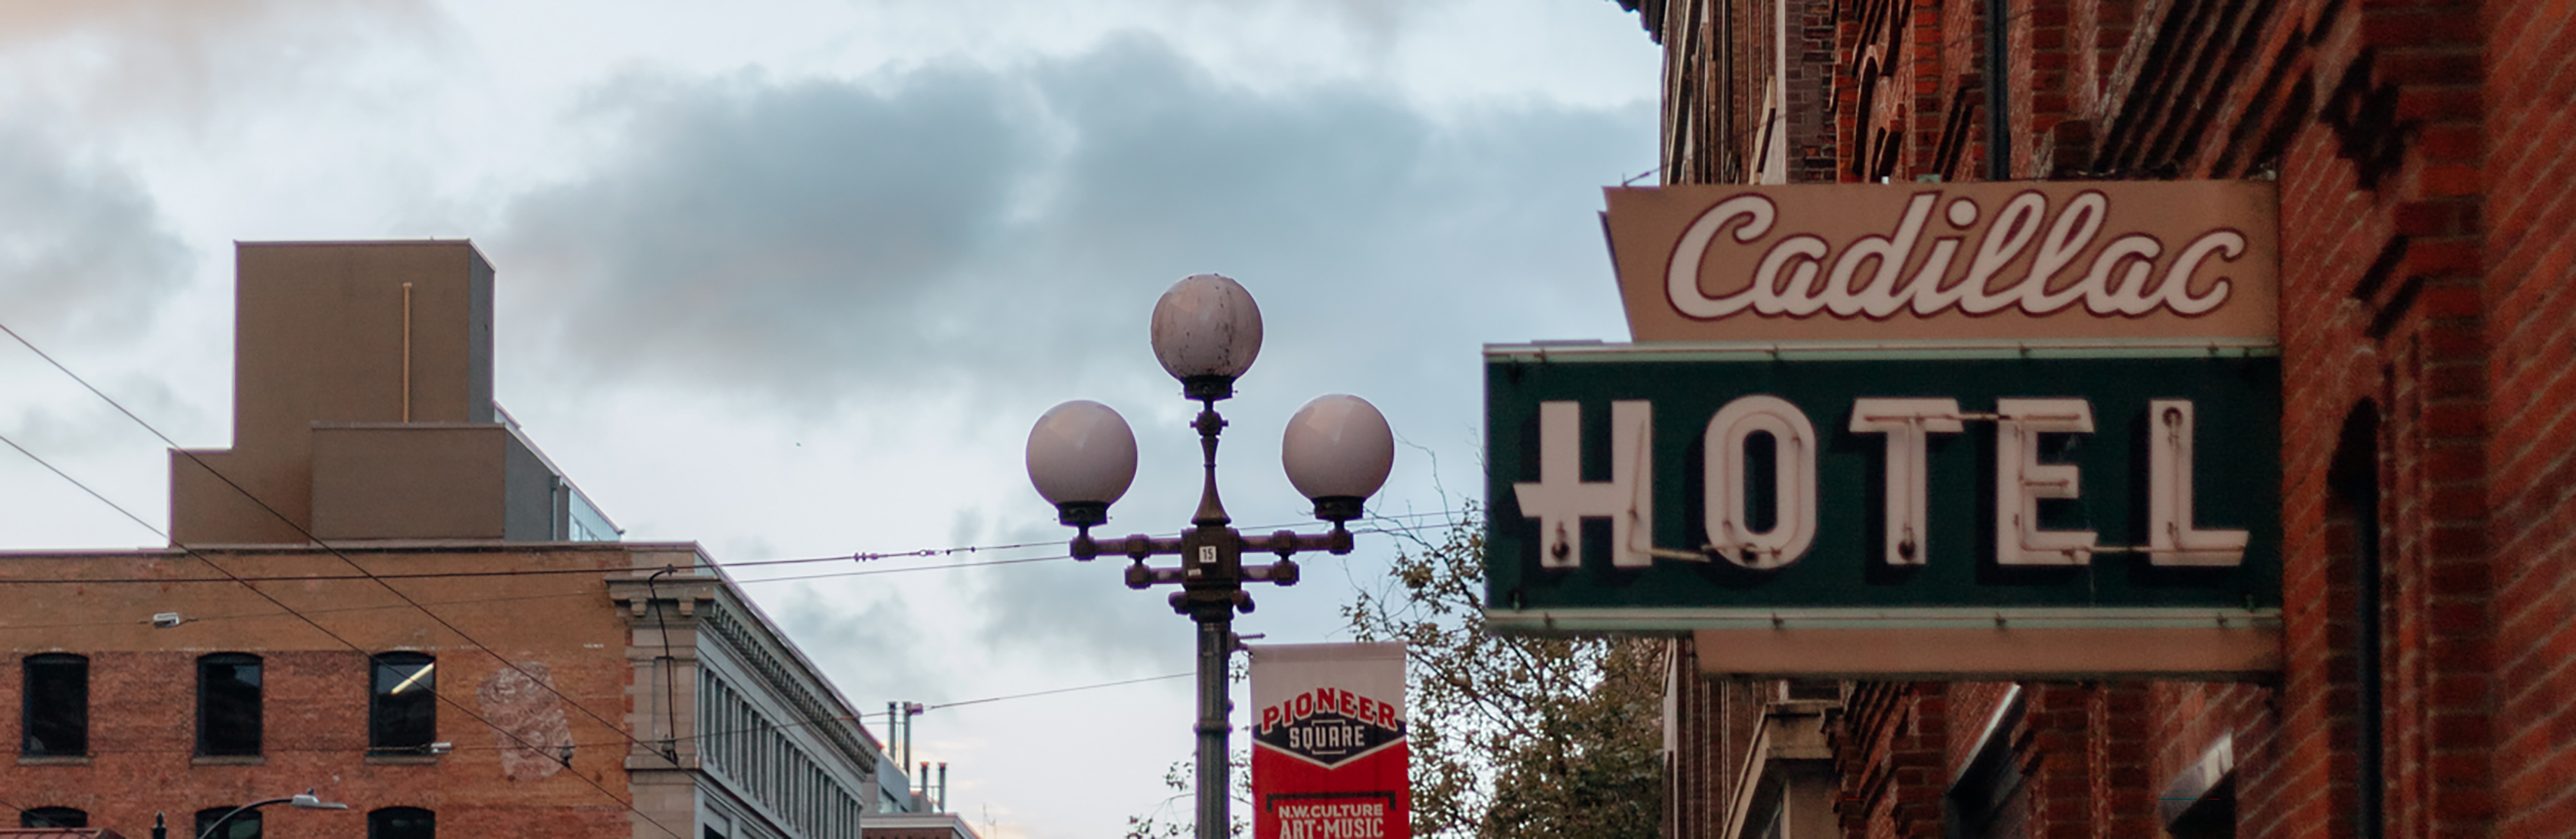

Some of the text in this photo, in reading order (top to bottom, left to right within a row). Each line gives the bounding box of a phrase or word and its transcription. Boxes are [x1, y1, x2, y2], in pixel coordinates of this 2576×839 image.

[1666, 190, 2247, 322] Cadillac
[1512, 395, 2249, 568] HOTEL
[1203, 548, 1213, 561] 15
[1261, 687, 1398, 734] PIONEER
[1289, 726, 1365, 750] SQUARE
